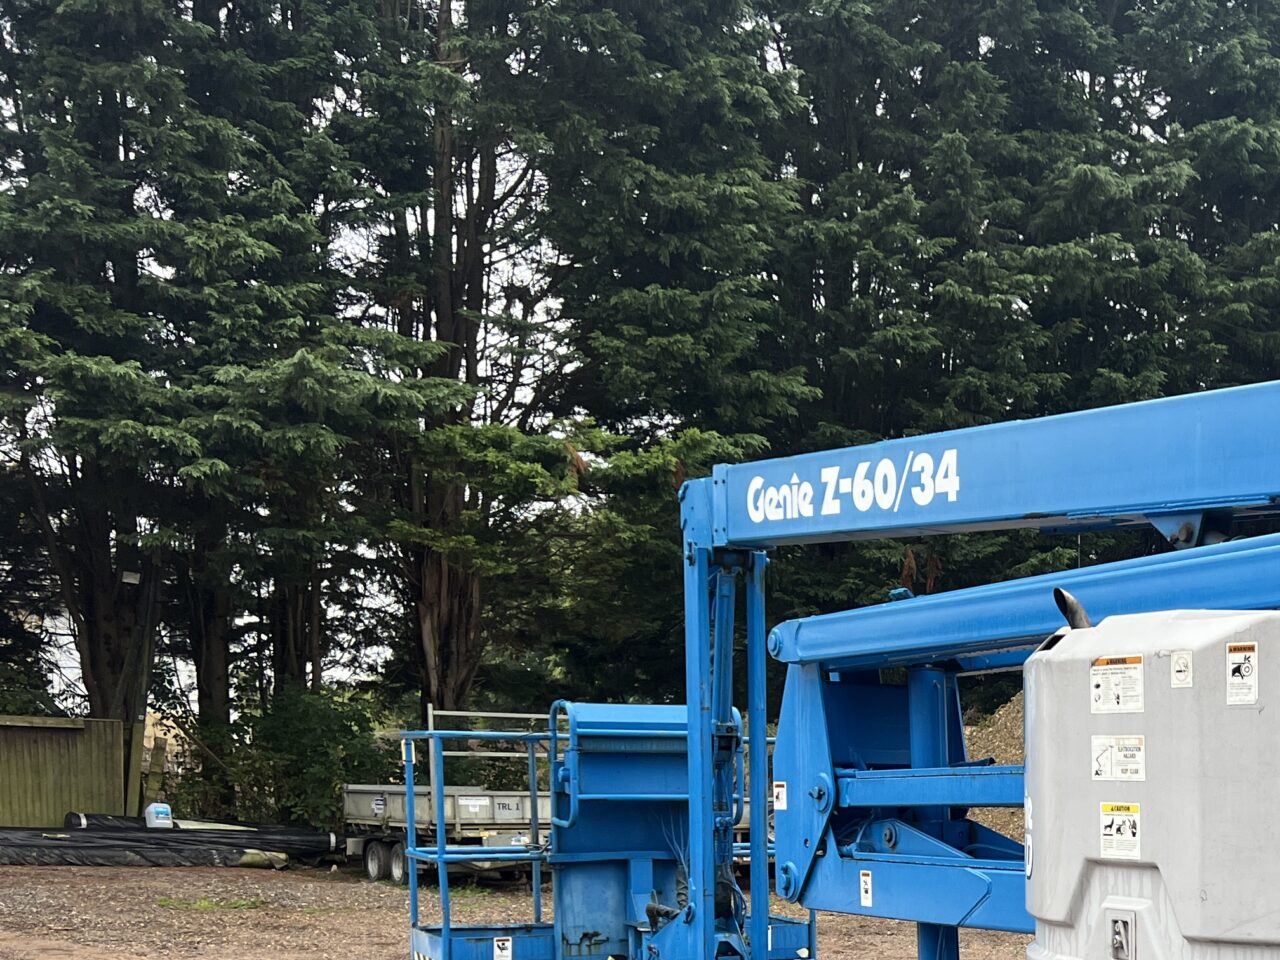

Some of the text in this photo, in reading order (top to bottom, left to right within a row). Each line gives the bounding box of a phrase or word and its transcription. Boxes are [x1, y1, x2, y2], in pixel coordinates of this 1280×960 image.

[747, 449, 960, 523] Genie Z-60/34
[496, 802, 512, 811] TRL
